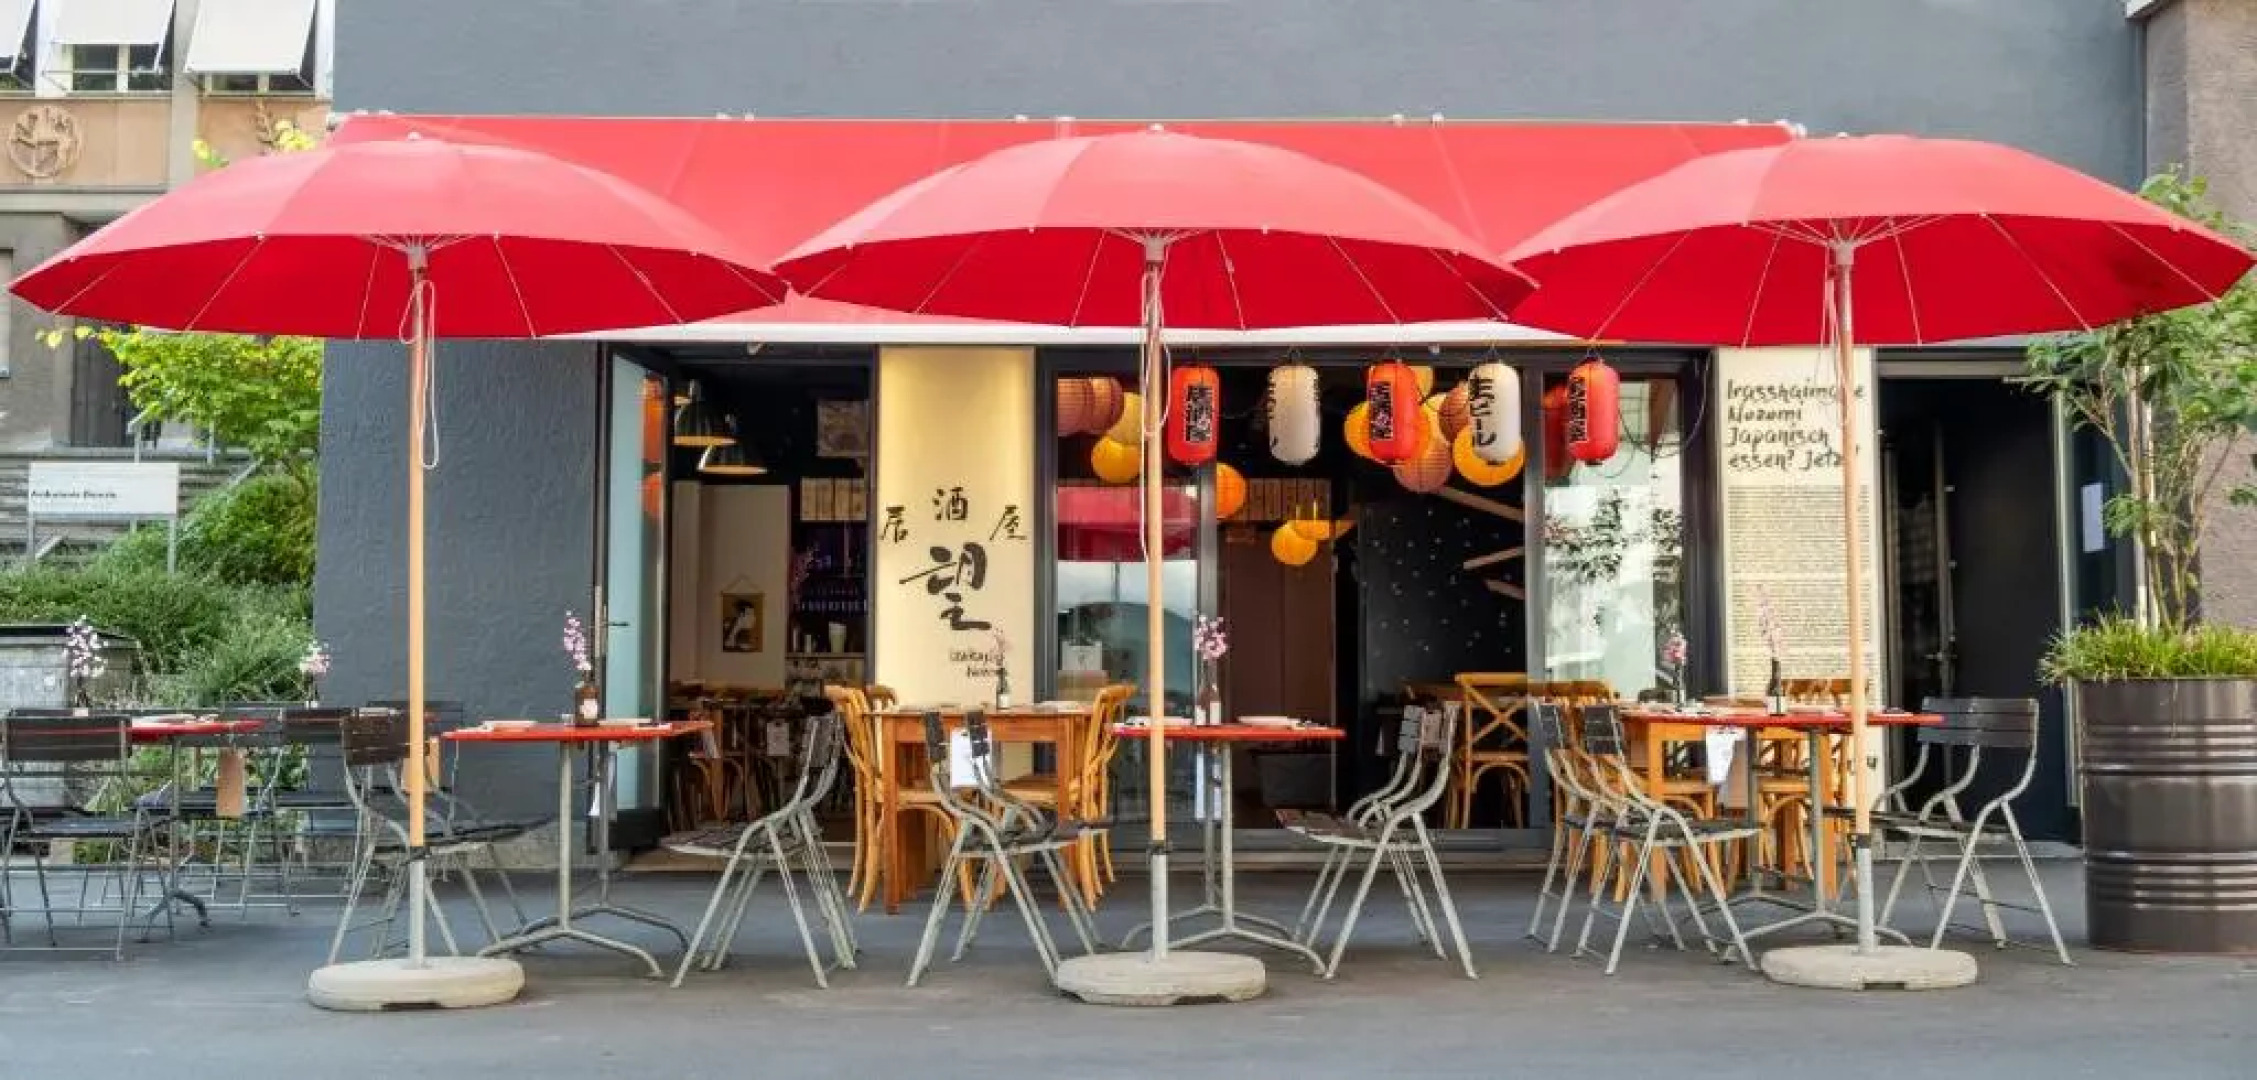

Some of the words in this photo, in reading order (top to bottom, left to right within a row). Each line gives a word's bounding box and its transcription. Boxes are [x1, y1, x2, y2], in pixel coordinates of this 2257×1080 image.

[1727, 378, 1866, 404] Irasshaimae
[1725, 422, 1830, 451] Japanisch
[1728, 449, 1795, 470] essen?
